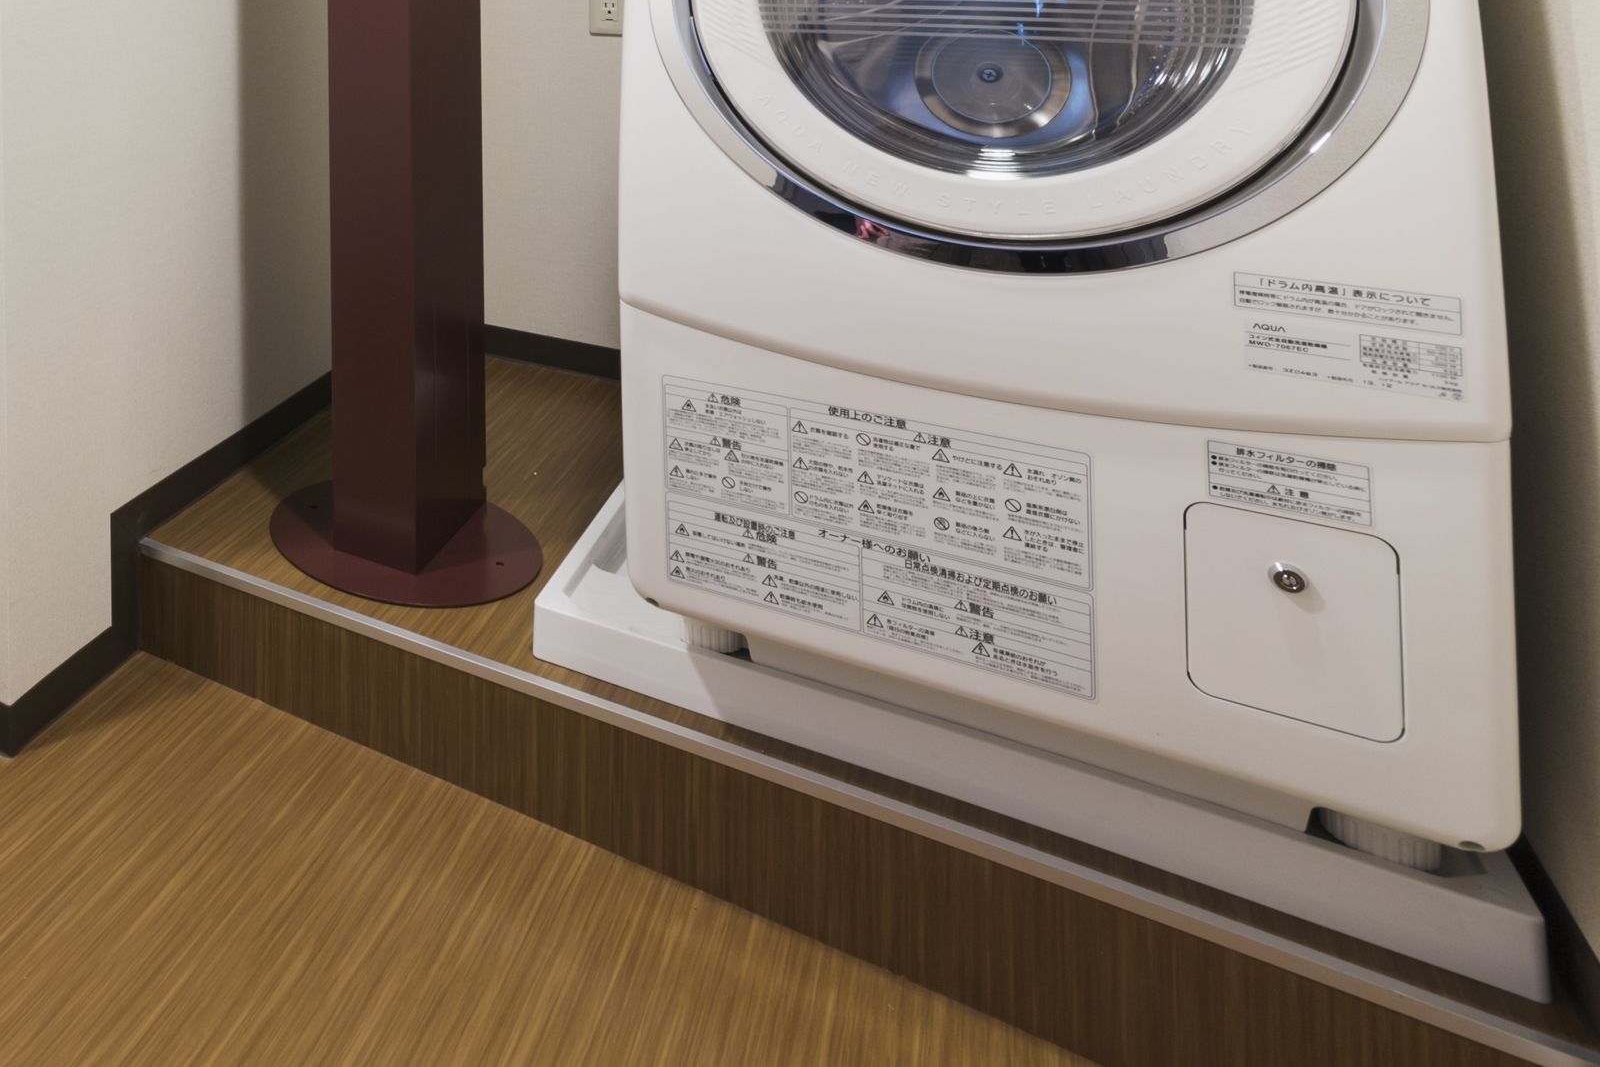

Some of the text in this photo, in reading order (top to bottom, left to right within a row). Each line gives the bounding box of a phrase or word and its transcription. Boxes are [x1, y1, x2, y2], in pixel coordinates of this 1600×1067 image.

[1252, 322, 1285, 332] AQUA
[1249, 340, 1308, 352] MWD-7067EC
[828, 406, 906, 429] 使用上のご注意
[927, 434, 951, 448] 注意
[818, 528, 930, 563] オーナー様へのお願い
